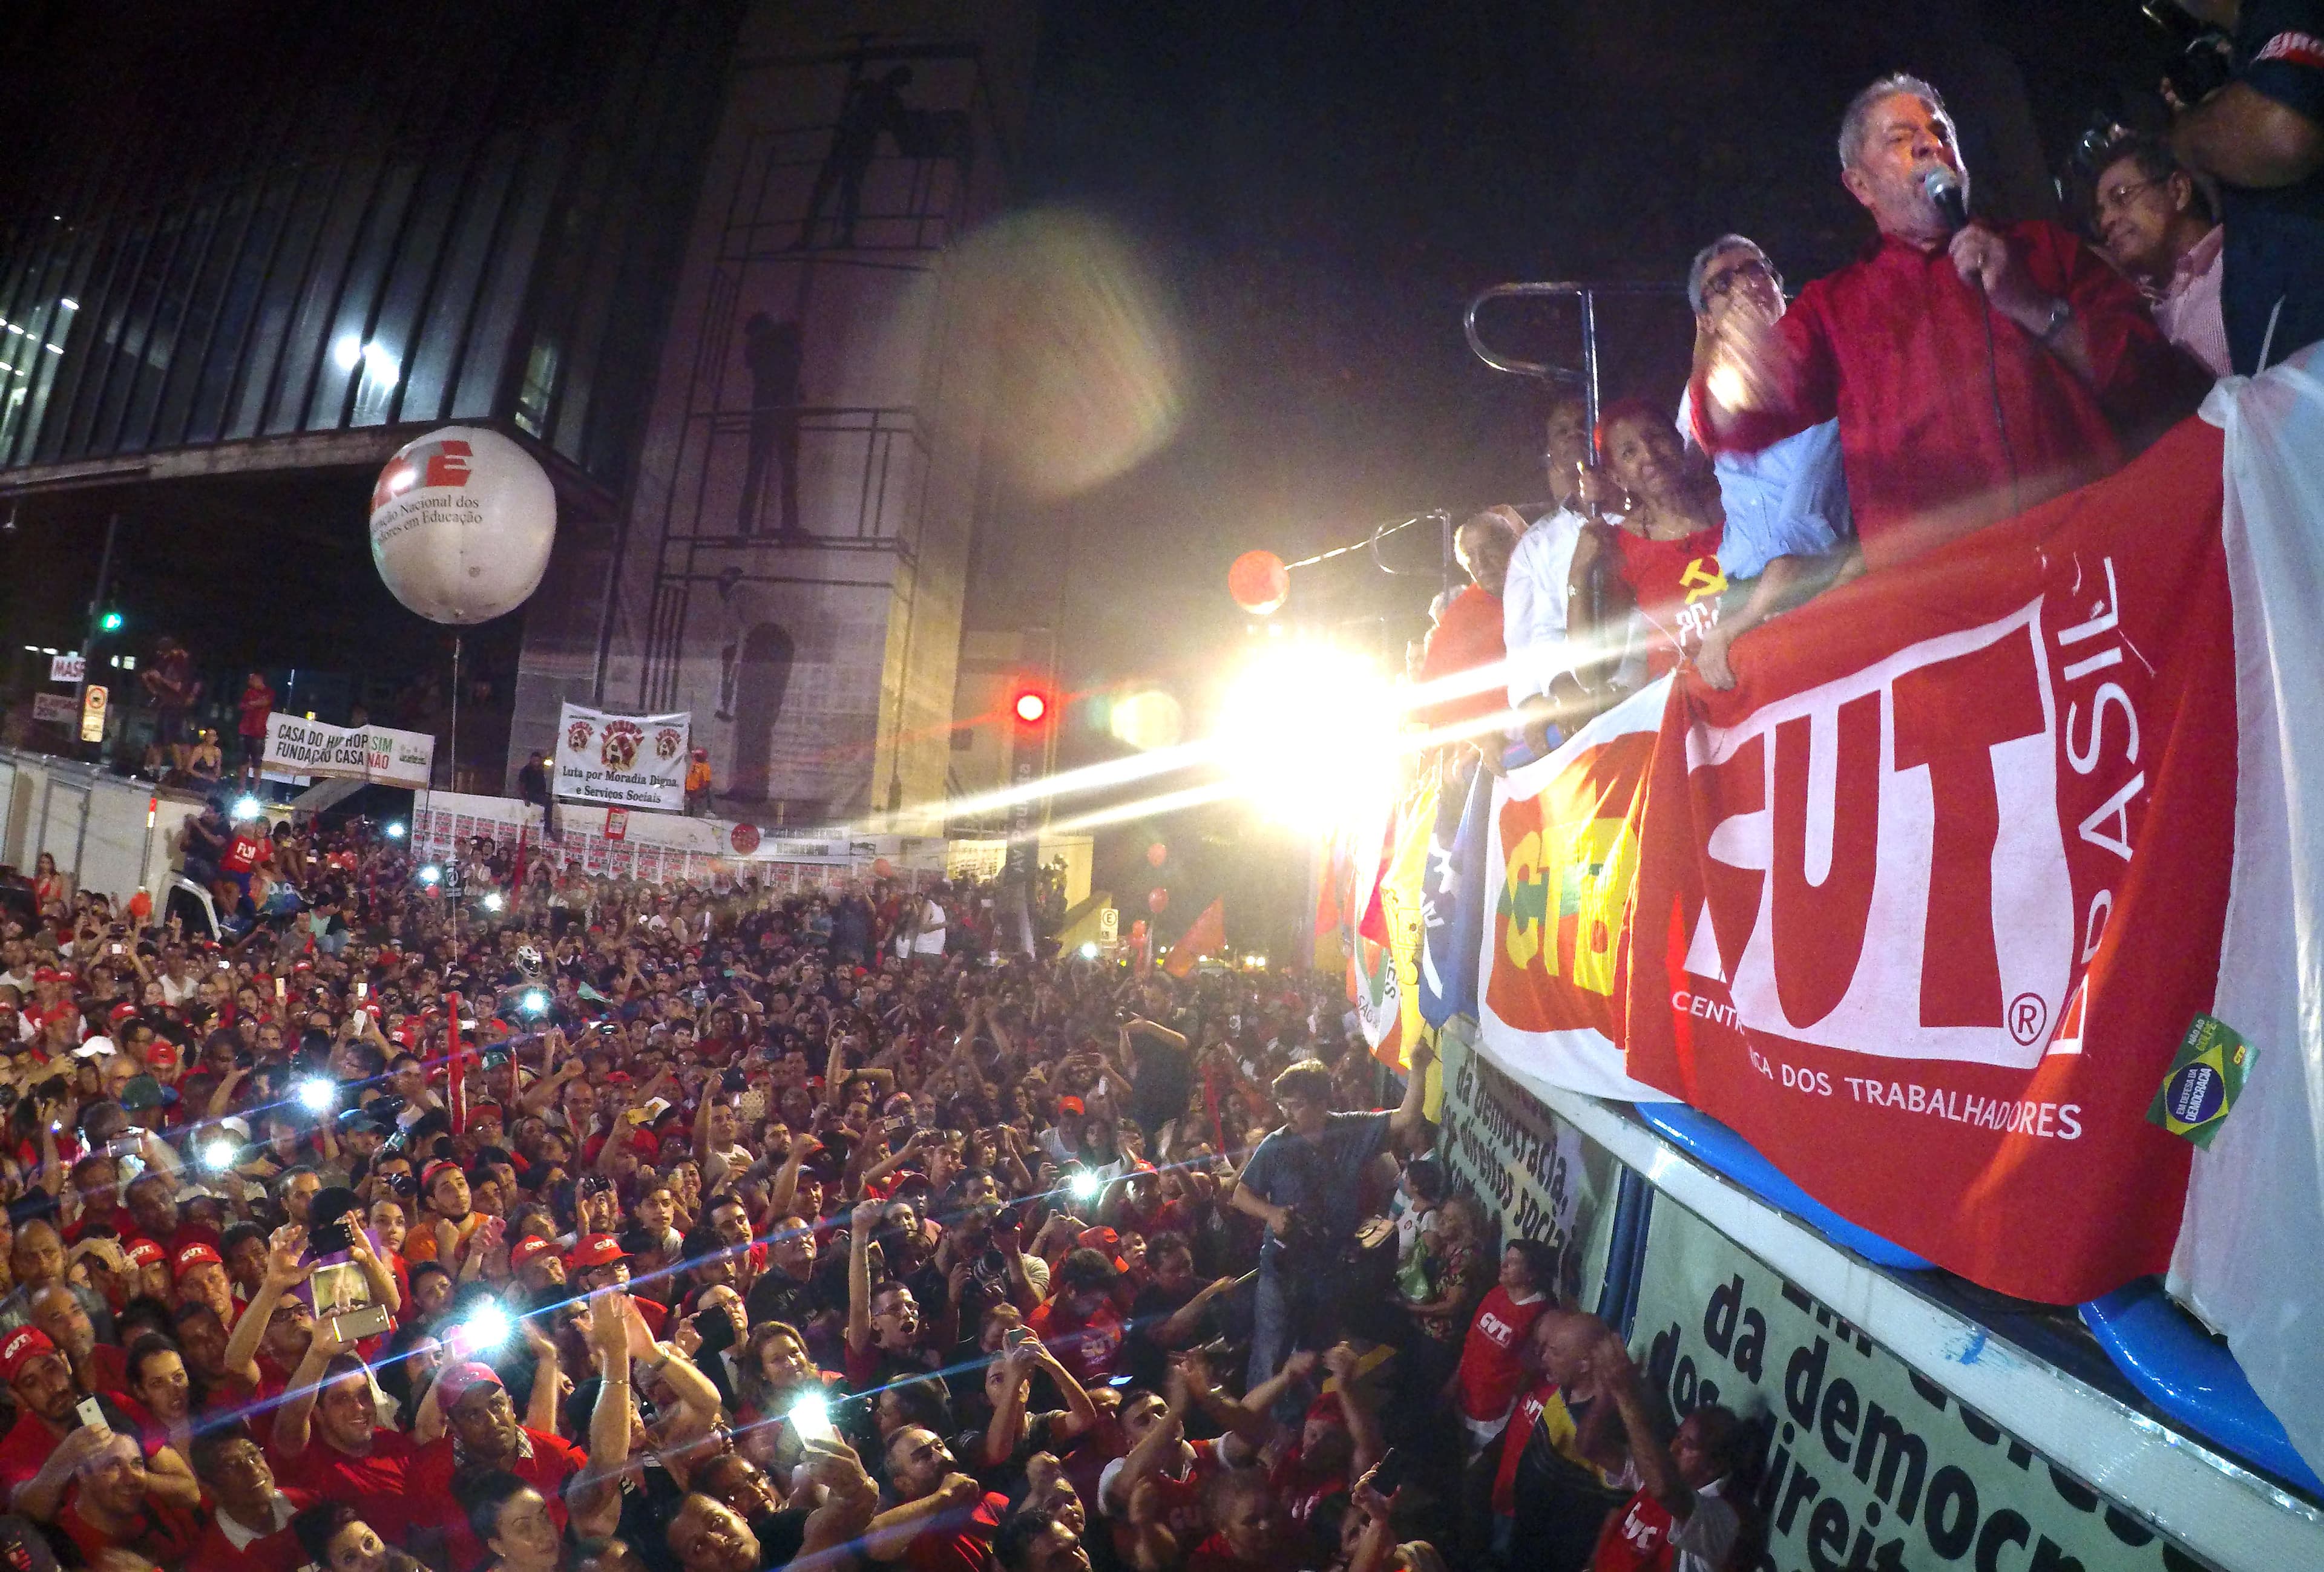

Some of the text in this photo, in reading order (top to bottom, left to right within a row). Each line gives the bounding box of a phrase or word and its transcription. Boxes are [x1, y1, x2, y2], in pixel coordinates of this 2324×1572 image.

[400, 495, 451, 514] Nacional
[456, 496, 479, 508] dos
[404, 517, 420, 530] em
[423, 511, 483, 525] Educação
[278, 724, 304, 744] CASA
[307, 732, 324, 747] DO
[346, 734, 369, 748] HOP
[372, 735, 393, 752] SIM
[276, 742, 332, 765] FUNDAÇÃO
[335, 748, 364, 765] CASA
[367, 752, 389, 770] NÃO
[563, 766, 583, 778] Luta
[586, 770, 603, 782] por
[605, 770, 646, 785] Moradia
[584, 785, 623, 801] Serviços
[626, 789, 661, 804] Sociais
[2188, 1018, 2205, 1047] NÃO AO
[2195, 1020, 2218, 1051] GOLPE
[1456, 1059, 1473, 1107] da
[2176, 1069, 2198, 1115] EM DEFESA DA
[2185, 1068, 2212, 1121] DEMOCRACIA
[1782, 1064, 1833, 1097] DOS
[1843, 1077, 2083, 1141] TRABALHADORES
[182, 1247, 202, 1262] CUT
[594, 1239, 616, 1250] CUT
[1480, 1312, 1512, 1341] CUT
[1704, 1273, 1767, 1385] da
[5, 1334, 27, 1359] CUT
